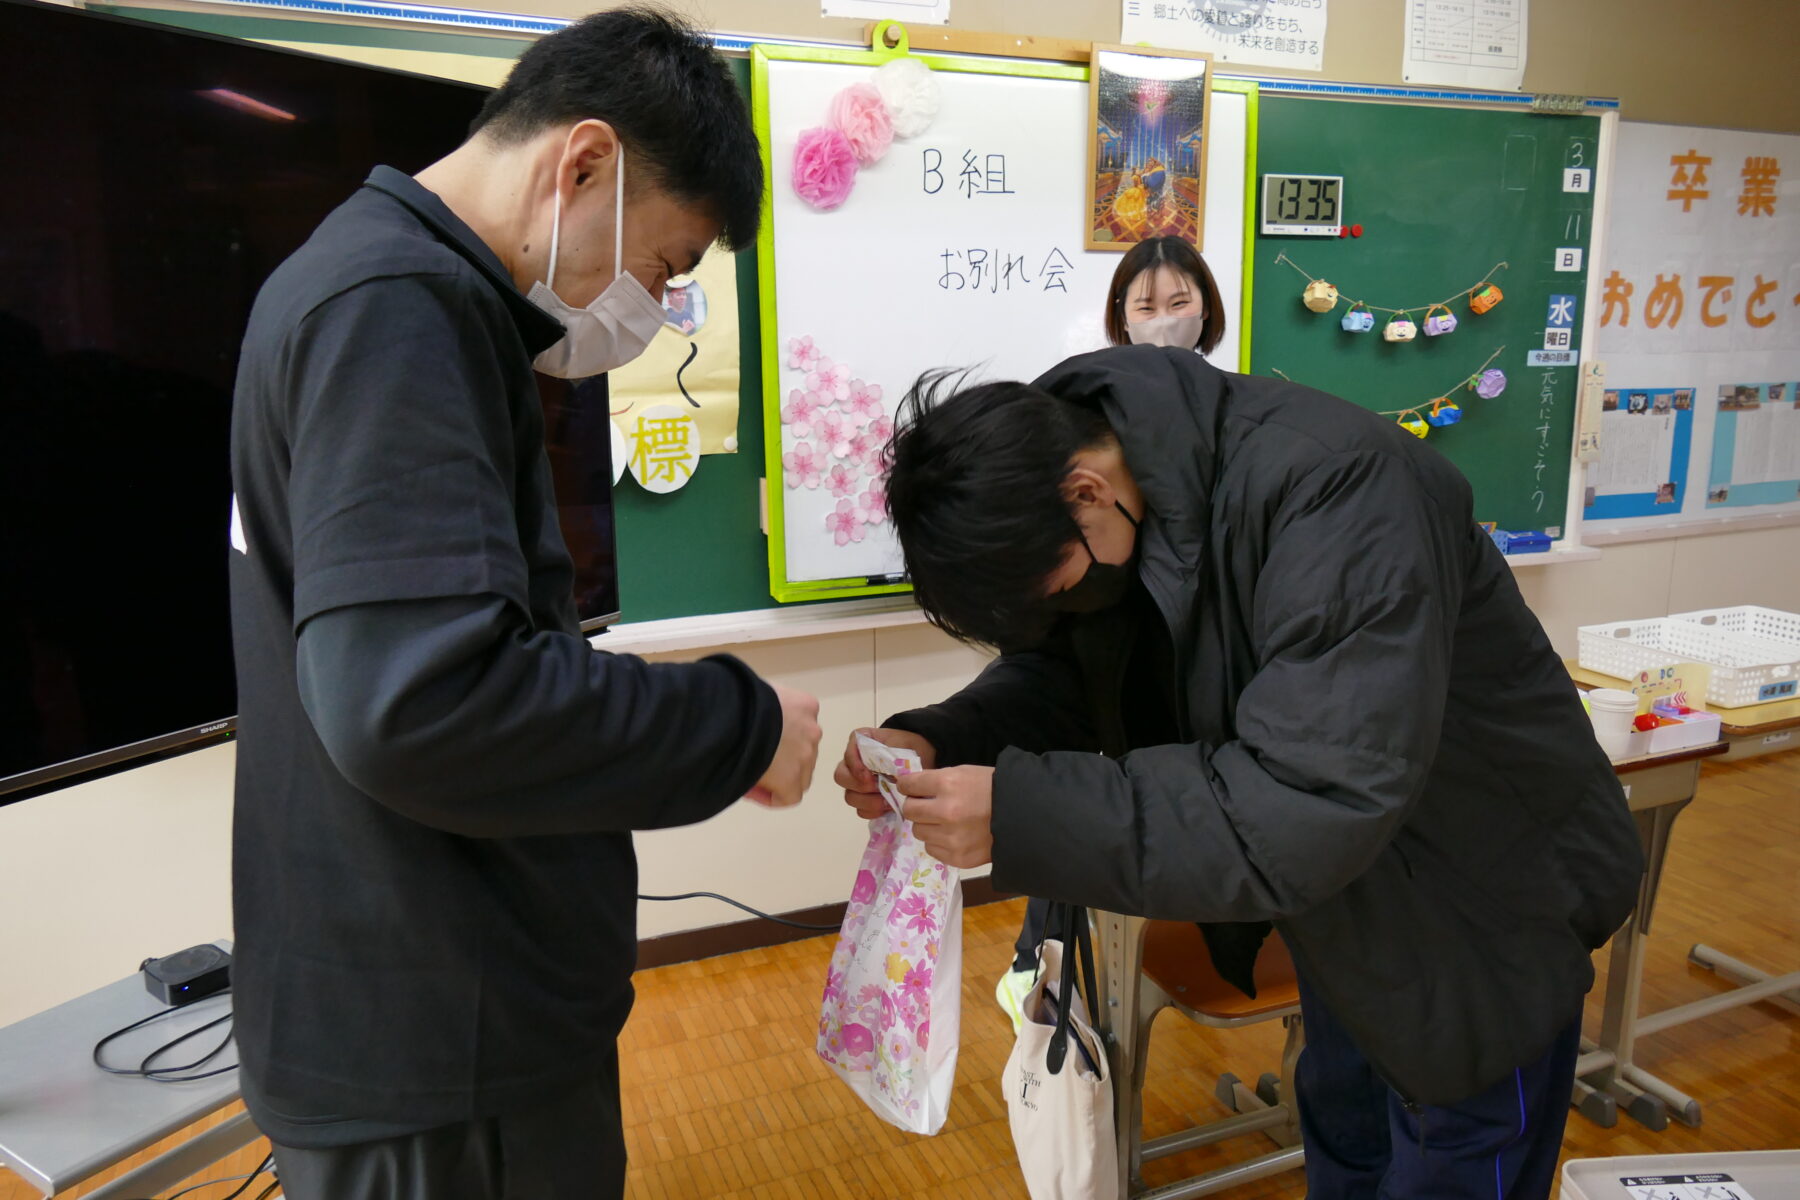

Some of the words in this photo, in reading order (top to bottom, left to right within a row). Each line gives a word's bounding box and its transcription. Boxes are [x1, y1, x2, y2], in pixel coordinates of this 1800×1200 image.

[1238, 34, 1319, 55] 未来を創造する
[1571, 142, 1584, 168] 3
[1571, 173, 1583, 188] 月
[1666, 149, 1781, 218] 卒業
[938, 247, 1074, 294] お別れ会
[1563, 253, 1574, 267] 日
[1548, 296, 1573, 325] 水
[1600, 270, 1800, 329] おめでと
[1546, 331, 1569, 346] 曜日
[630, 415, 692, 486] 標
[200, 722, 228, 733] SHARP
